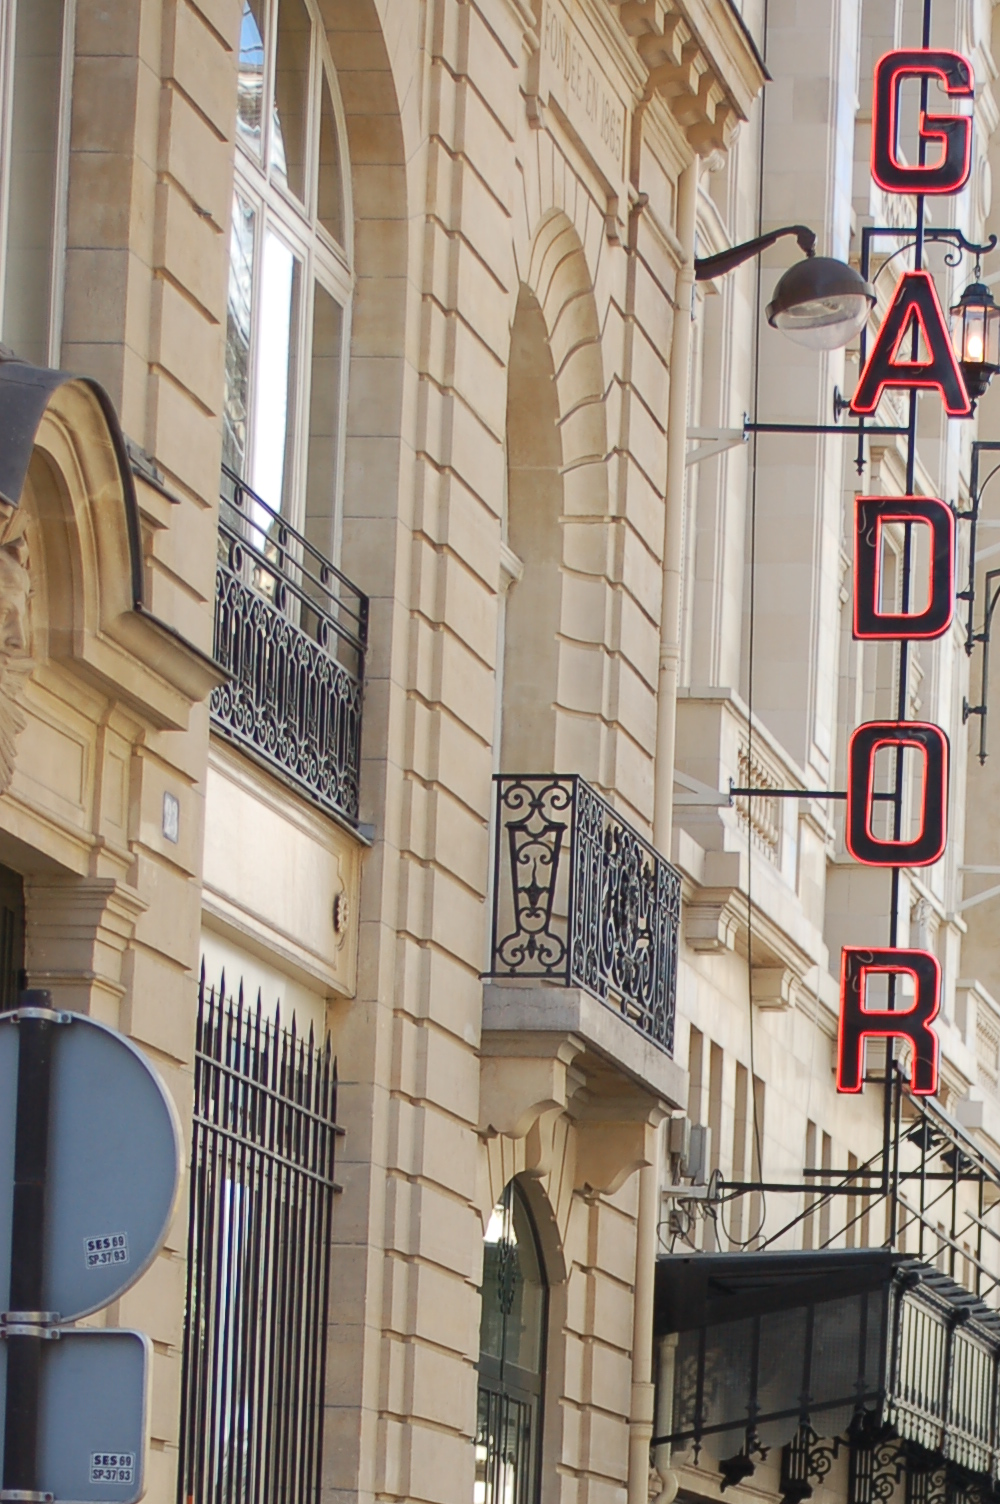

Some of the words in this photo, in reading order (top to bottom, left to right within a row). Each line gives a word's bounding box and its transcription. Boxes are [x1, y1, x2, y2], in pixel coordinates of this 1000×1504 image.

[586, 67, 600, 122] EN
[601, 92, 622, 163] 1865
[87, 1238, 110, 1251] SES
[112, 1236, 124, 1247] 69
[114, 1250, 126, 1261] 93
[94, 1455, 117, 1466] SES
[119, 1456, 132, 1466] 69
[119, 1470, 131, 1481] 93
